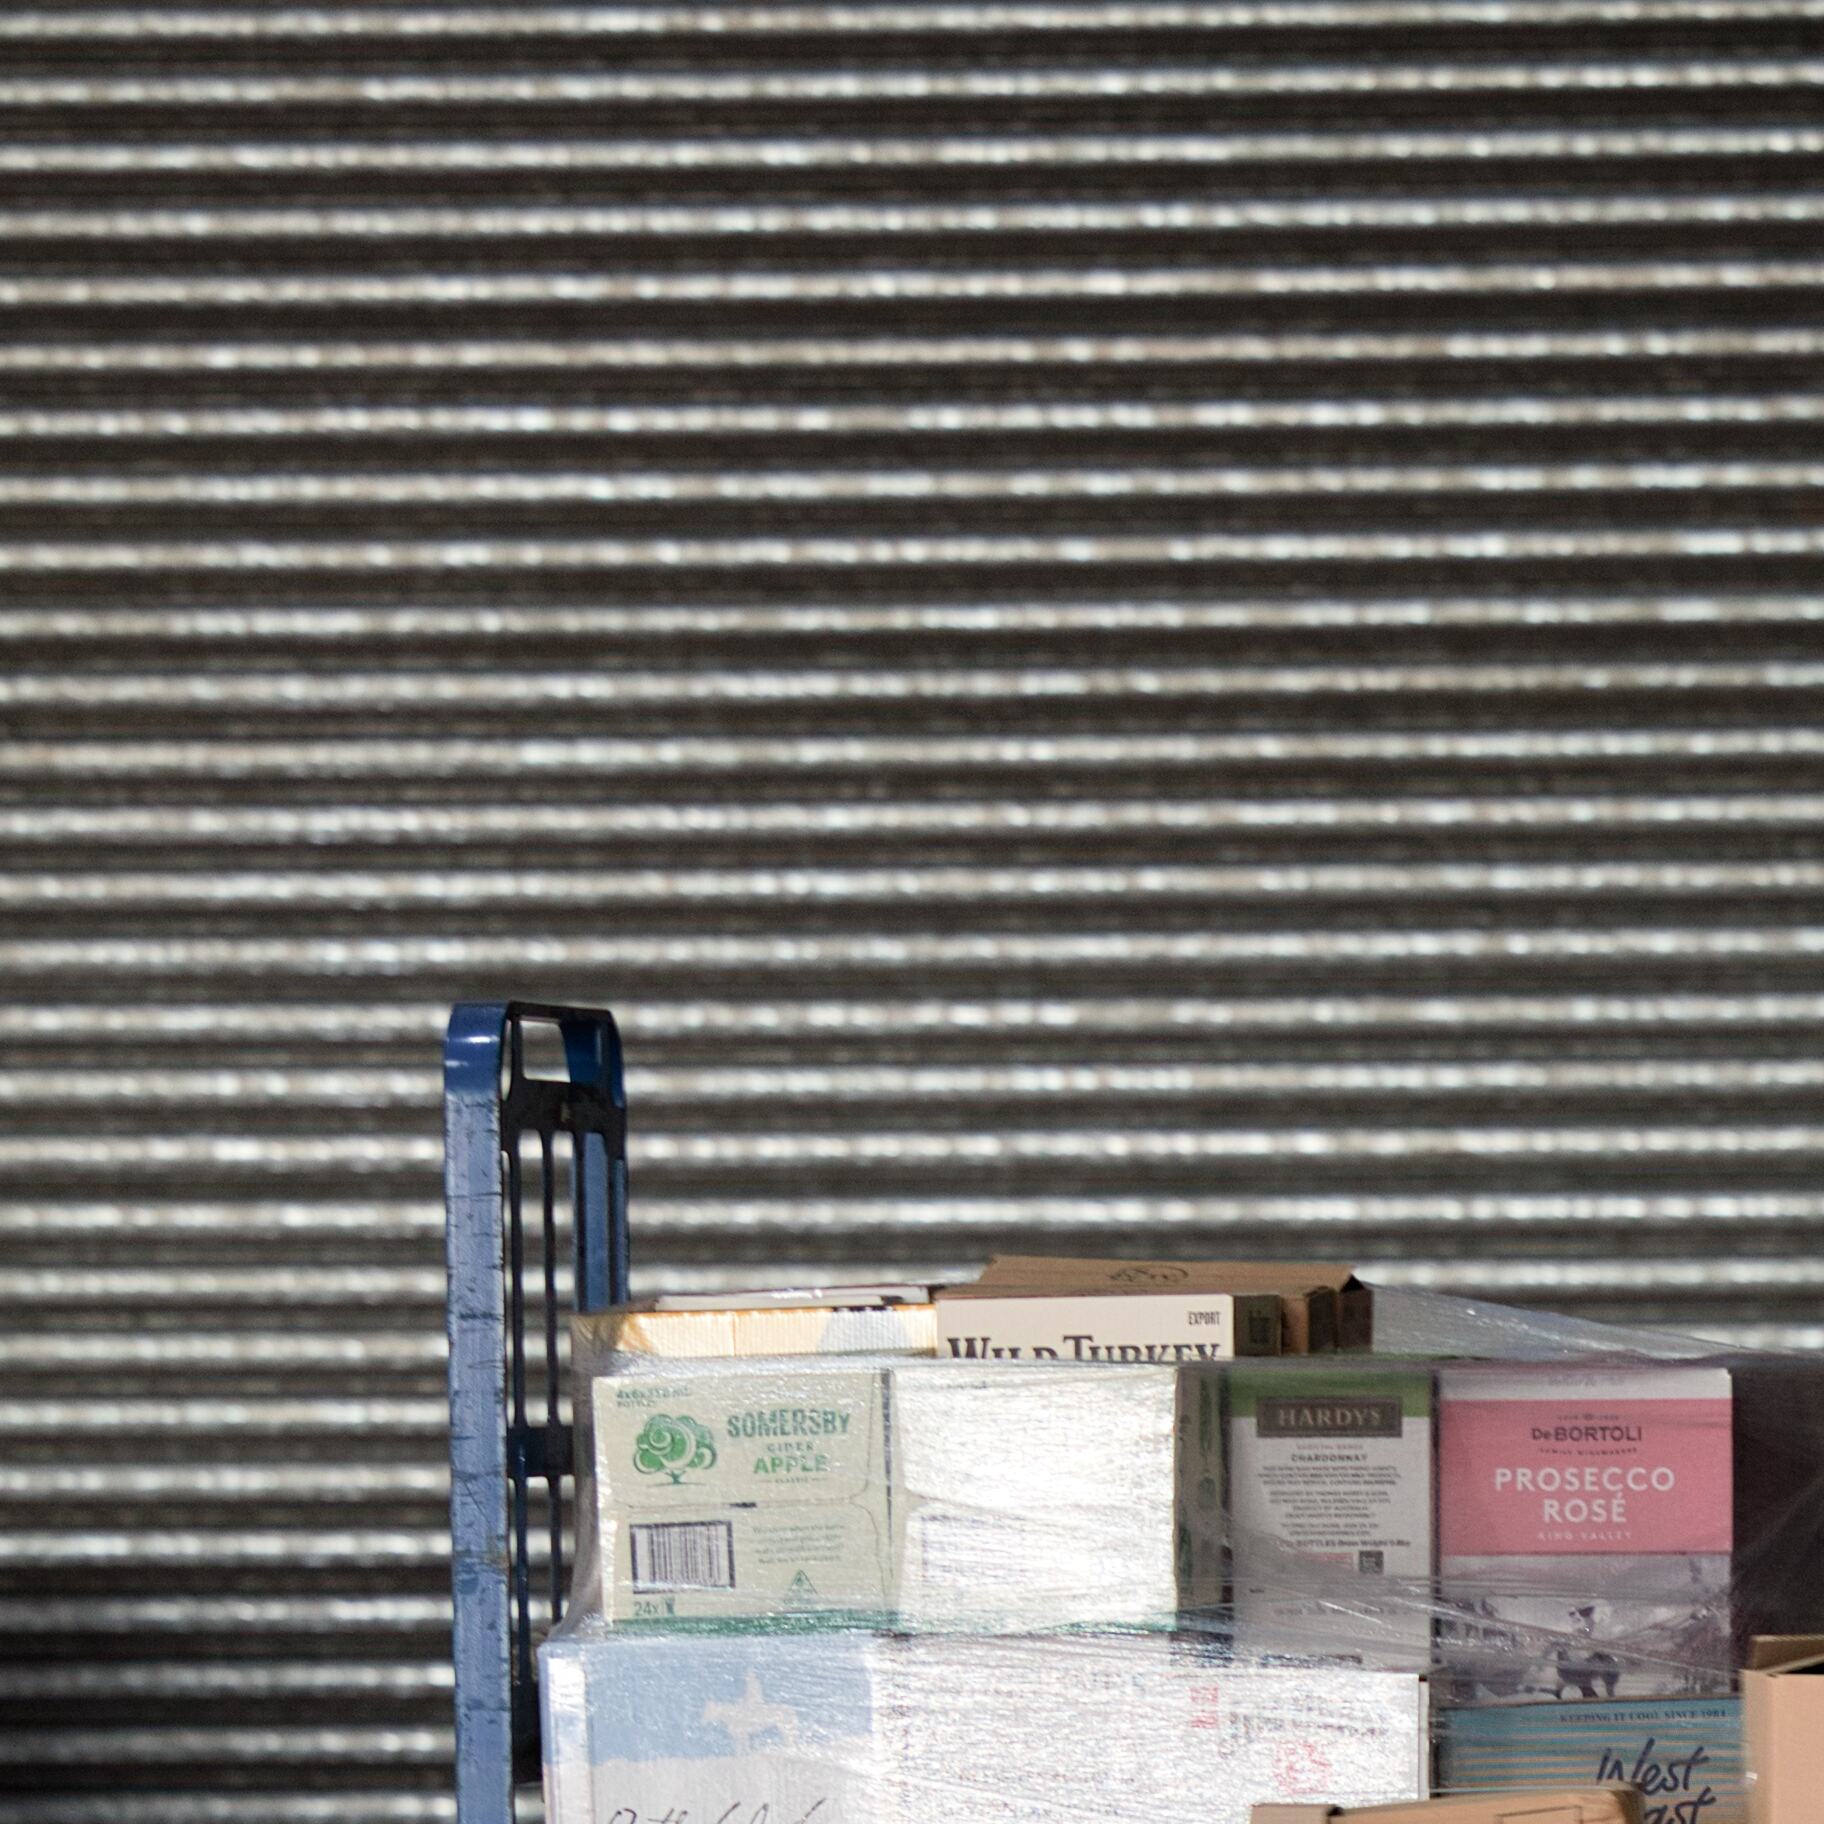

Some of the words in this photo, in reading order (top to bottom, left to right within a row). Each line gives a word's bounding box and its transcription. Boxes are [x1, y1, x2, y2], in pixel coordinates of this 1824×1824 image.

[1188, 1311, 1222, 1326] EXPORT
[726, 1407, 851, 1440] SOMERSBY
[1278, 1407, 1384, 1426] HARDYS
[766, 1441, 814, 1453] CIDER
[753, 1455, 829, 1475] APPLE
[1290, 1453, 1368, 1463] CHARDONNAY
[1494, 1466, 1675, 1492] PROSECCO
[1542, 1491, 1627, 1523] ROSÉ
[1559, 1710, 1611, 1722] KEEPING
[1613, 1711, 1625, 1721] IT
[1628, 1710, 1660, 1721] COOL
[1663, 1709, 1697, 1720] SINCE
